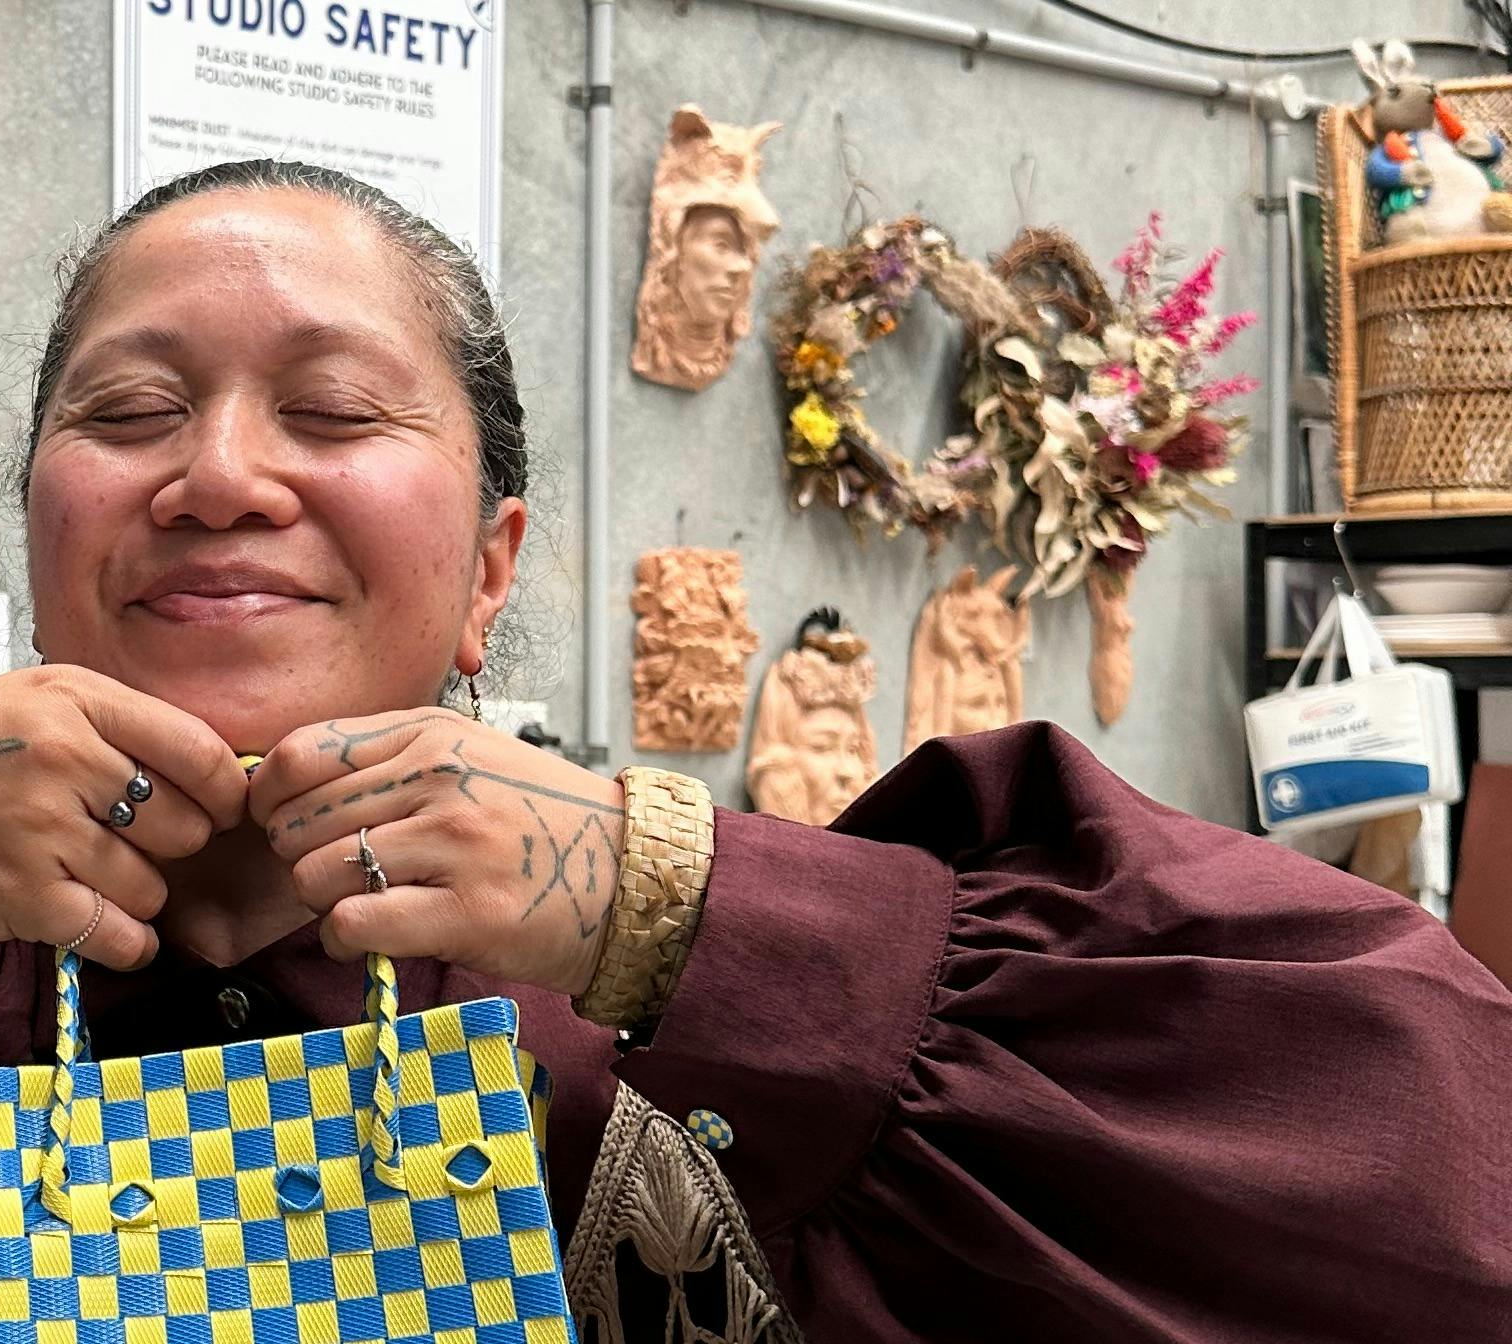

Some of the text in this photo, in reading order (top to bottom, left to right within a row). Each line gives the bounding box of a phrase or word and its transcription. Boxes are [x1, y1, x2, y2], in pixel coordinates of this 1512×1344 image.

[324, 2, 478, 71] SAFETY
[194, 64, 286, 95] FOLLOWING
[288, 80, 340, 105] STUDIO
[342, 90, 391, 113] SAFETY
[196, 44, 249, 69] PLEASE
[252, 52, 291, 75] READ
[294, 60, 326, 81] AND
[386, 76, 407, 94] TO
[409, 79, 434, 98] THE
